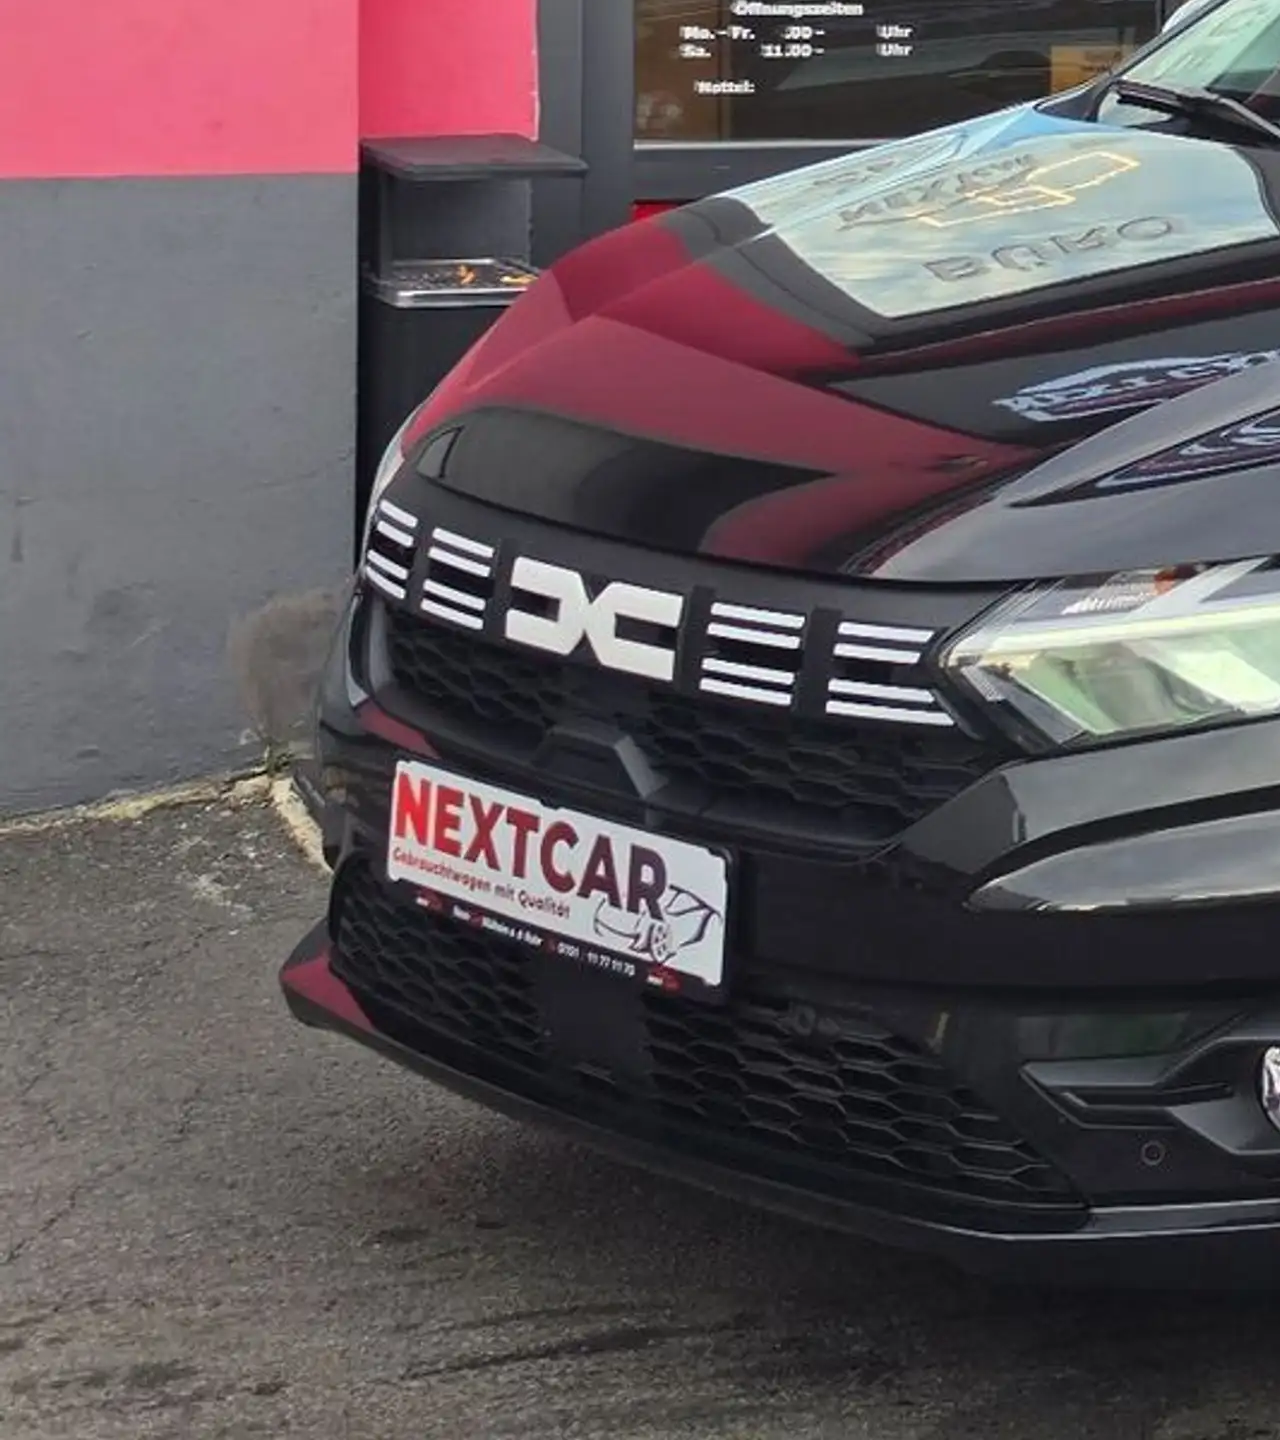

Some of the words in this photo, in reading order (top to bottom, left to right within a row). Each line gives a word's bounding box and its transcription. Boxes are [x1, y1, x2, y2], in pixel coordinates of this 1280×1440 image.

[731, 0, 865, 18] Öffnungszeiten
[876, 25, 914, 40] Uhr
[876, 43, 914, 57] Uhr
[394, 771, 668, 922] NEXTCAR
